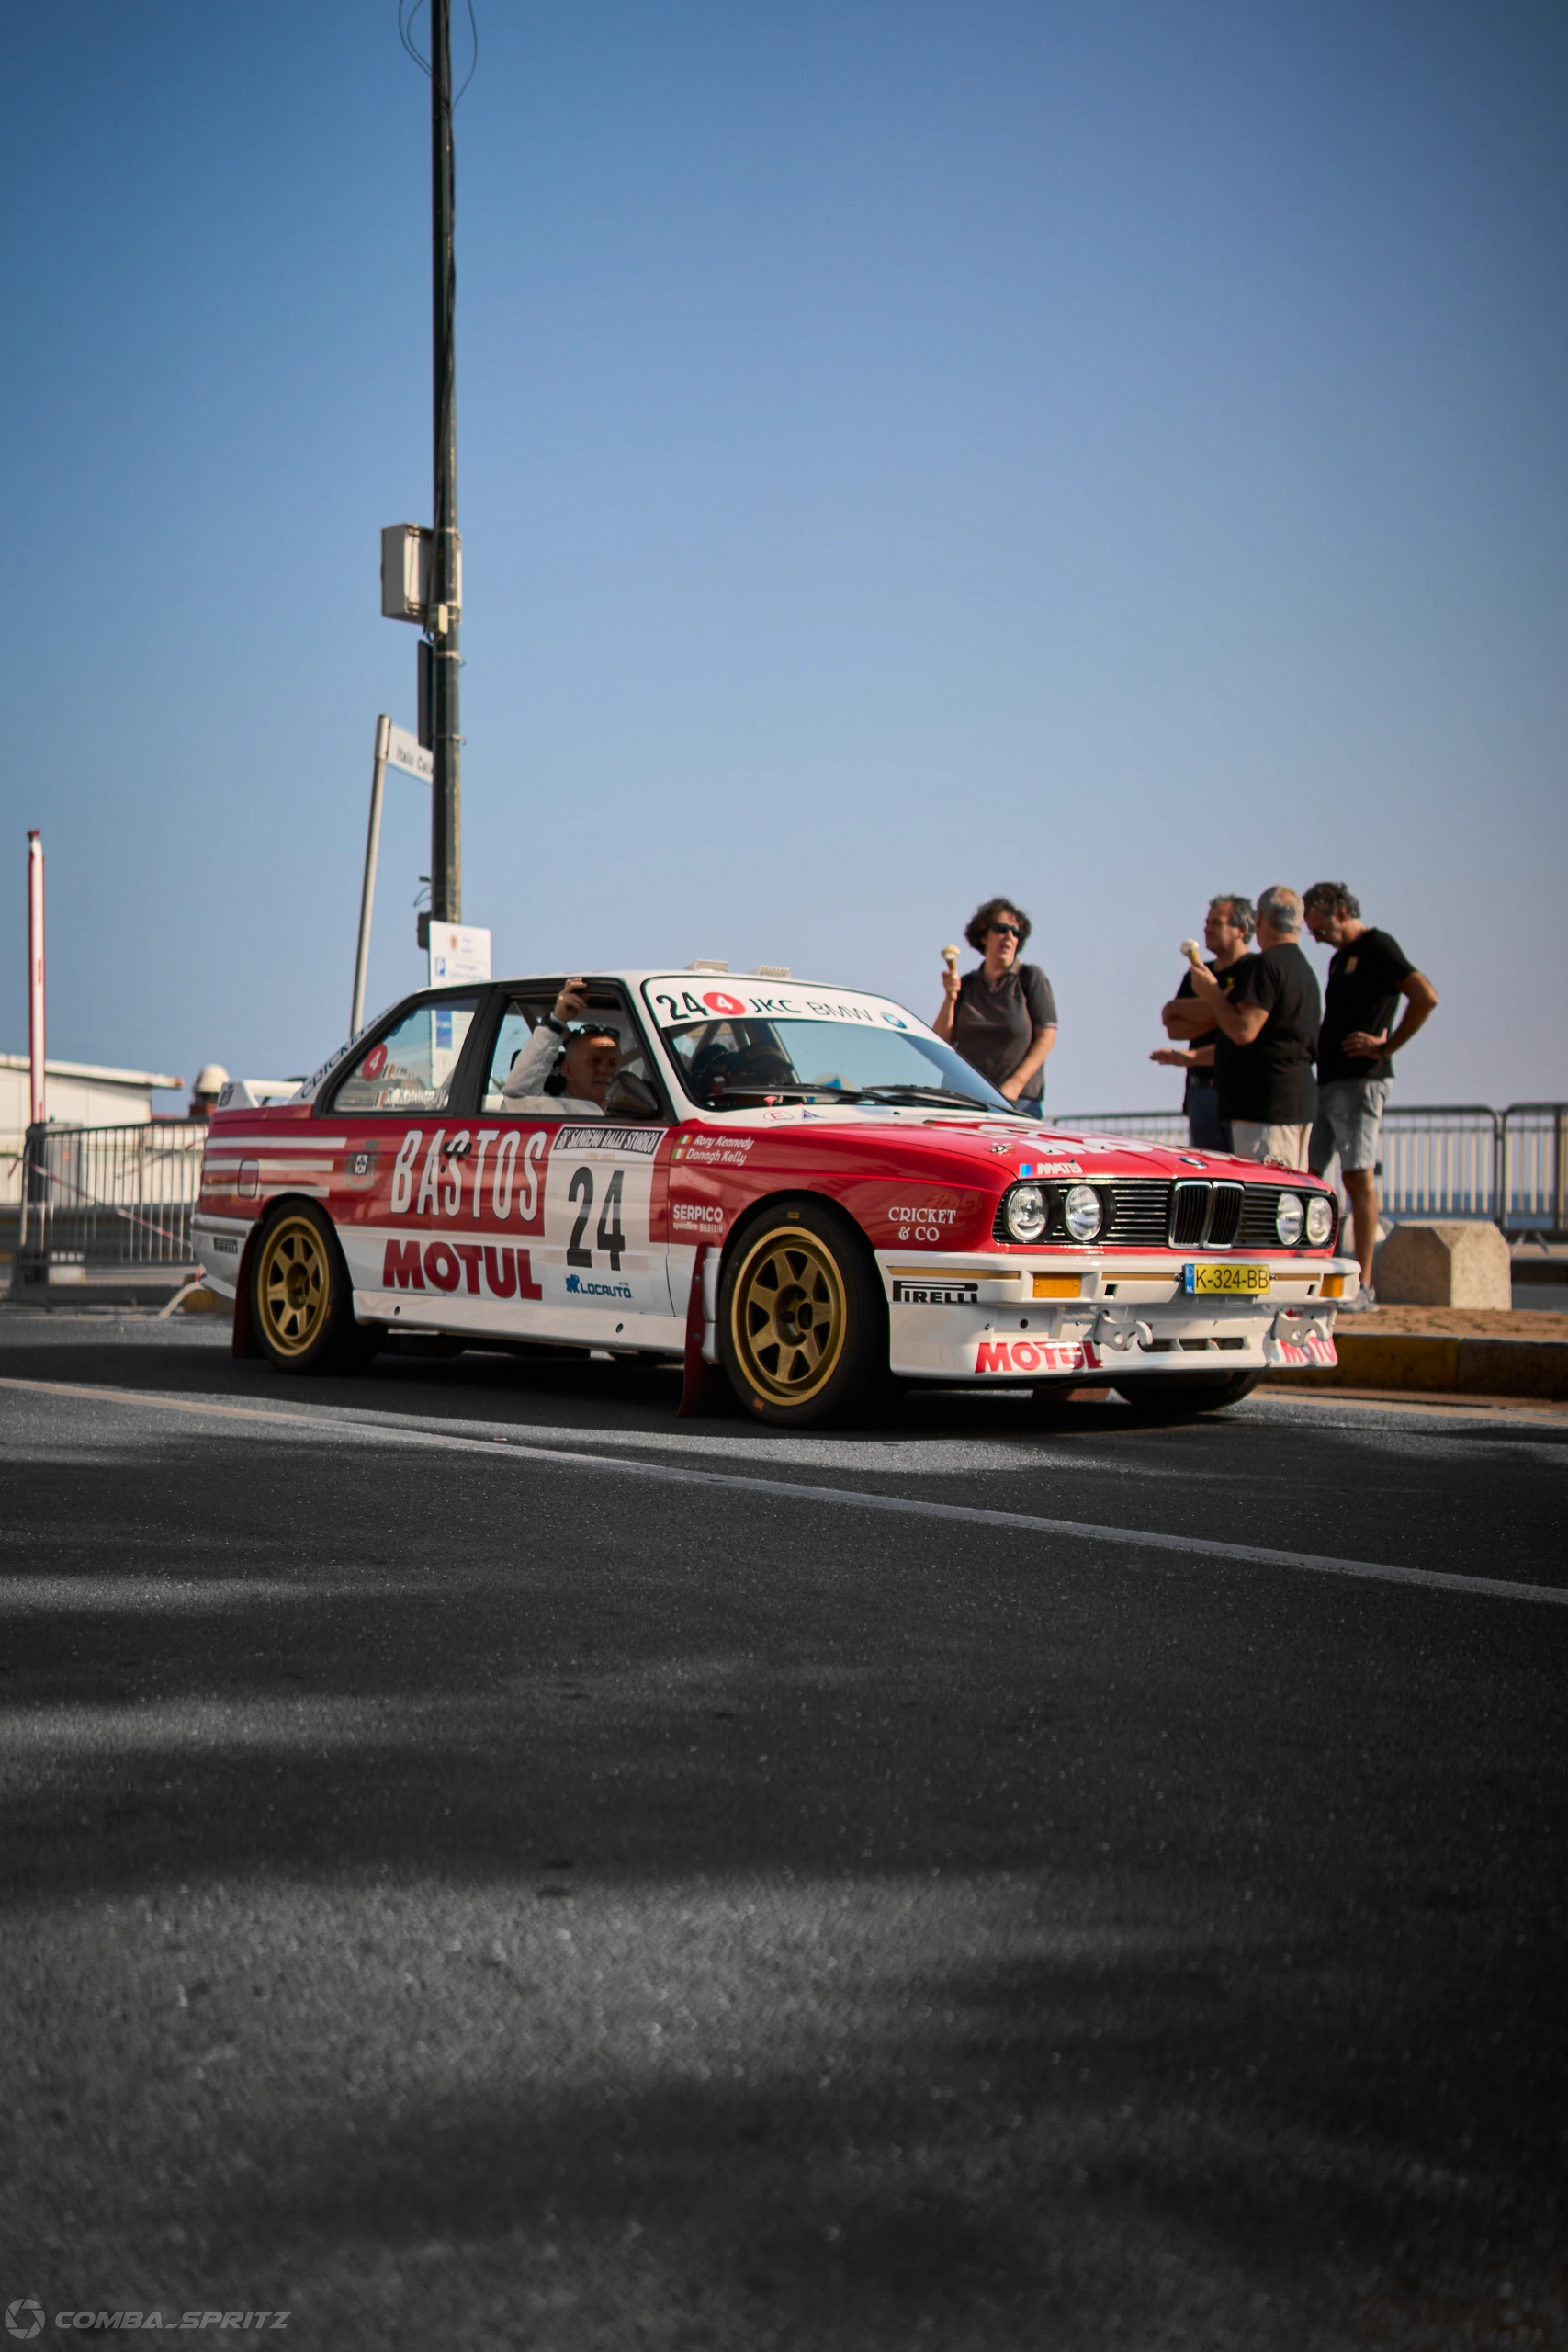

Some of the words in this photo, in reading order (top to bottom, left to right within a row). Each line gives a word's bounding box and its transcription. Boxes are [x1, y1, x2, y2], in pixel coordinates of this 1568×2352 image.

[656, 991, 708, 1021] 24
[716, 995, 734, 1011] 4
[748, 998, 801, 1013] JKC
[807, 1001, 873, 1022] BMW
[369, 1049, 381, 1071] 4
[601, 1130, 628, 1148] RALLY
[623, 1132, 660, 1153] STORICO
[694, 1135, 716, 1148] Rory
[716, 1136, 755, 1151] Kennedy
[686, 1148, 721, 1164] Donagh
[721, 1150, 748, 1167] Kelly
[390, 1128, 548, 1222] BASTOS
[567, 1166, 625, 1272] 24
[673, 1204, 723, 1223] SERPICO
[888, 1207, 956, 1224] CRICKET
[699, 1223, 723, 1233] BILSTEIN
[898, 1227, 910, 1240] &
[915, 1227, 940, 1241] CO
[382, 1239, 543, 1300] MOTUL
[1195, 1269, 1269, 1289] K-324-BB
[581, 1283, 632, 1298] LOCAUTO
[892, 1280, 979, 1304] PIRELLI
[975, 1341, 1103, 1374] MOTUL
